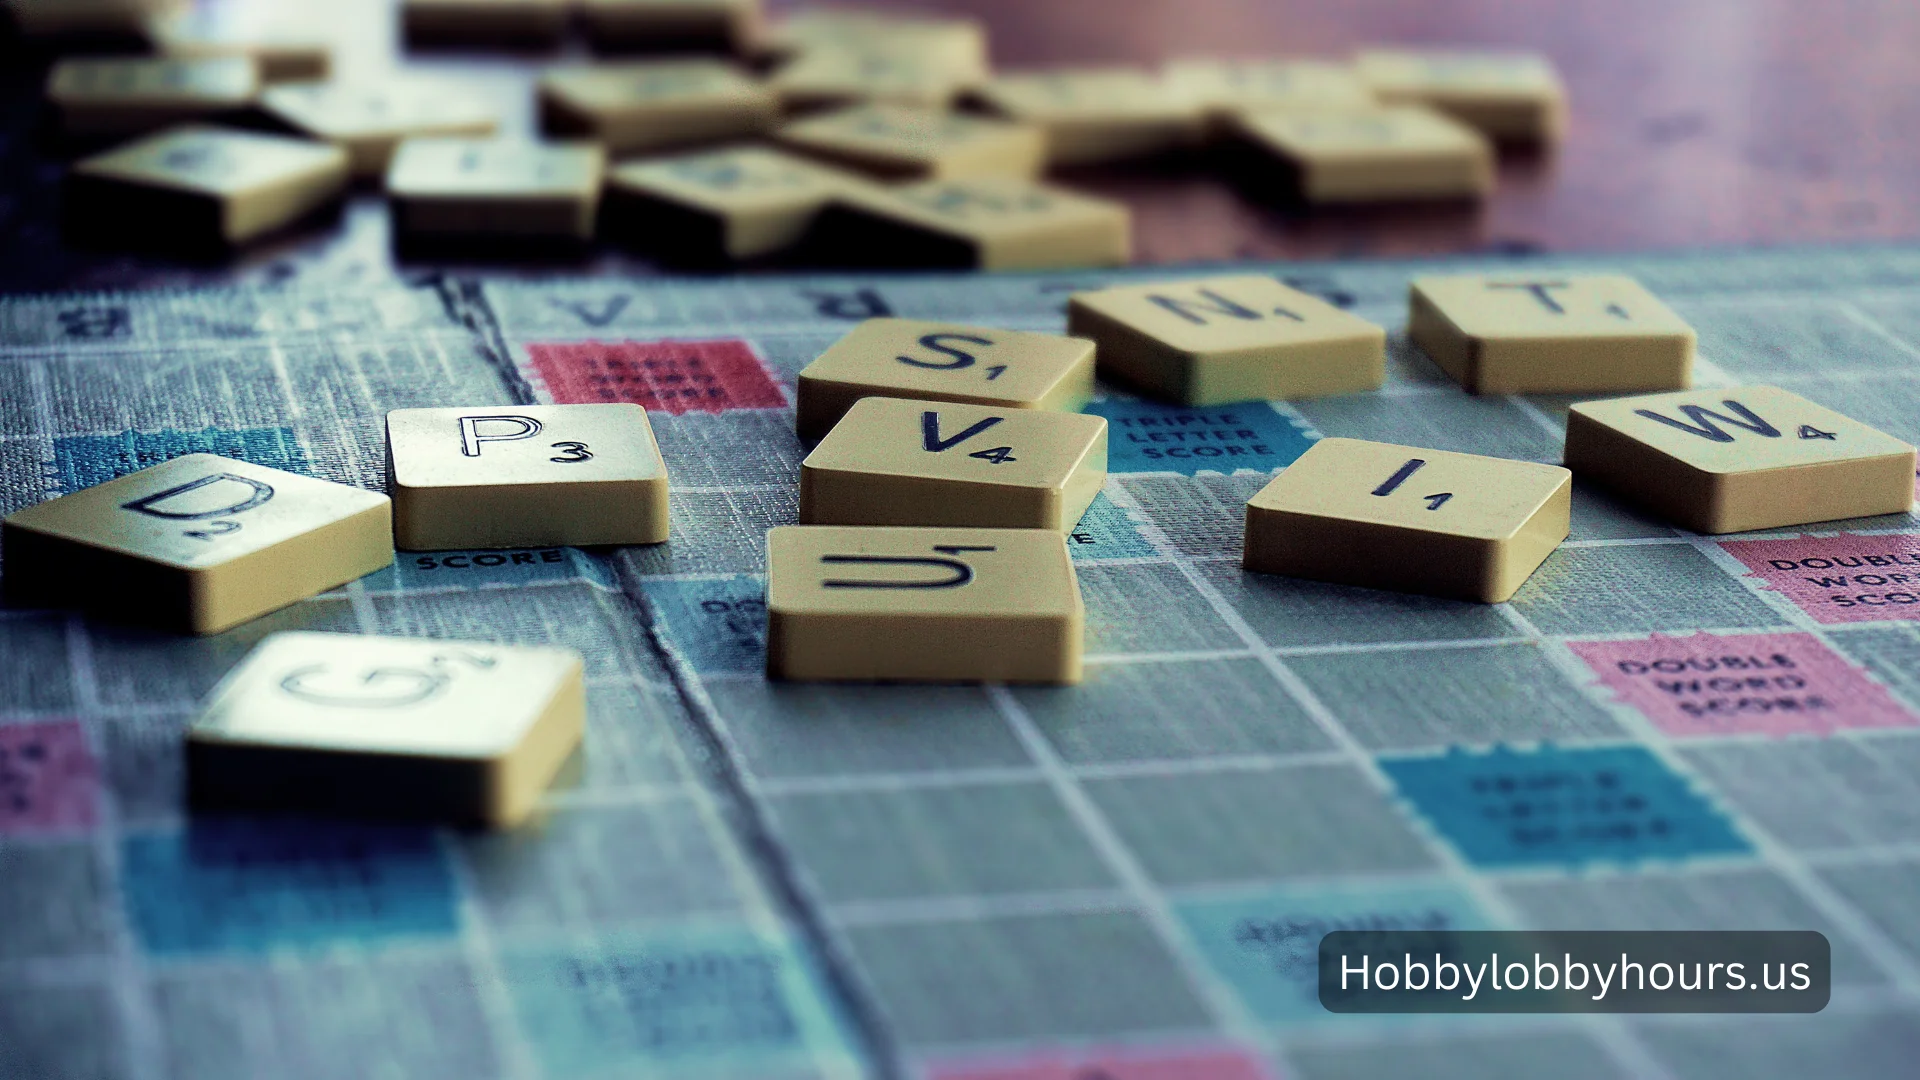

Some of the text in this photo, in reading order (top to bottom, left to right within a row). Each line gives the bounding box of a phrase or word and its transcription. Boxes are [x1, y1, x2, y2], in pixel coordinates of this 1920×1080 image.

[1145, 288, 1265, 325] N
[1485, 281, 1570, 315] T
[896, 333, 1008, 380] S 1
[920, 411, 1018, 464] V 4
[1116, 413, 1242, 428] TRIPLE
[1126, 429, 1260, 444] LETTER
[1633, 399, 1838, 443] W 4
[458, 415, 595, 463] P 3
[1142, 444, 1276, 459] SCORE
[120, 471, 276, 521] D
[1370, 458, 1455, 511] I 1
[416, 550, 564, 571] SCORE
[820, 554, 975, 590] U
[1804, 572, 1920, 588] WOR
[1831, 592, 1920, 607] SCO
[279, 662, 450, 708] G
